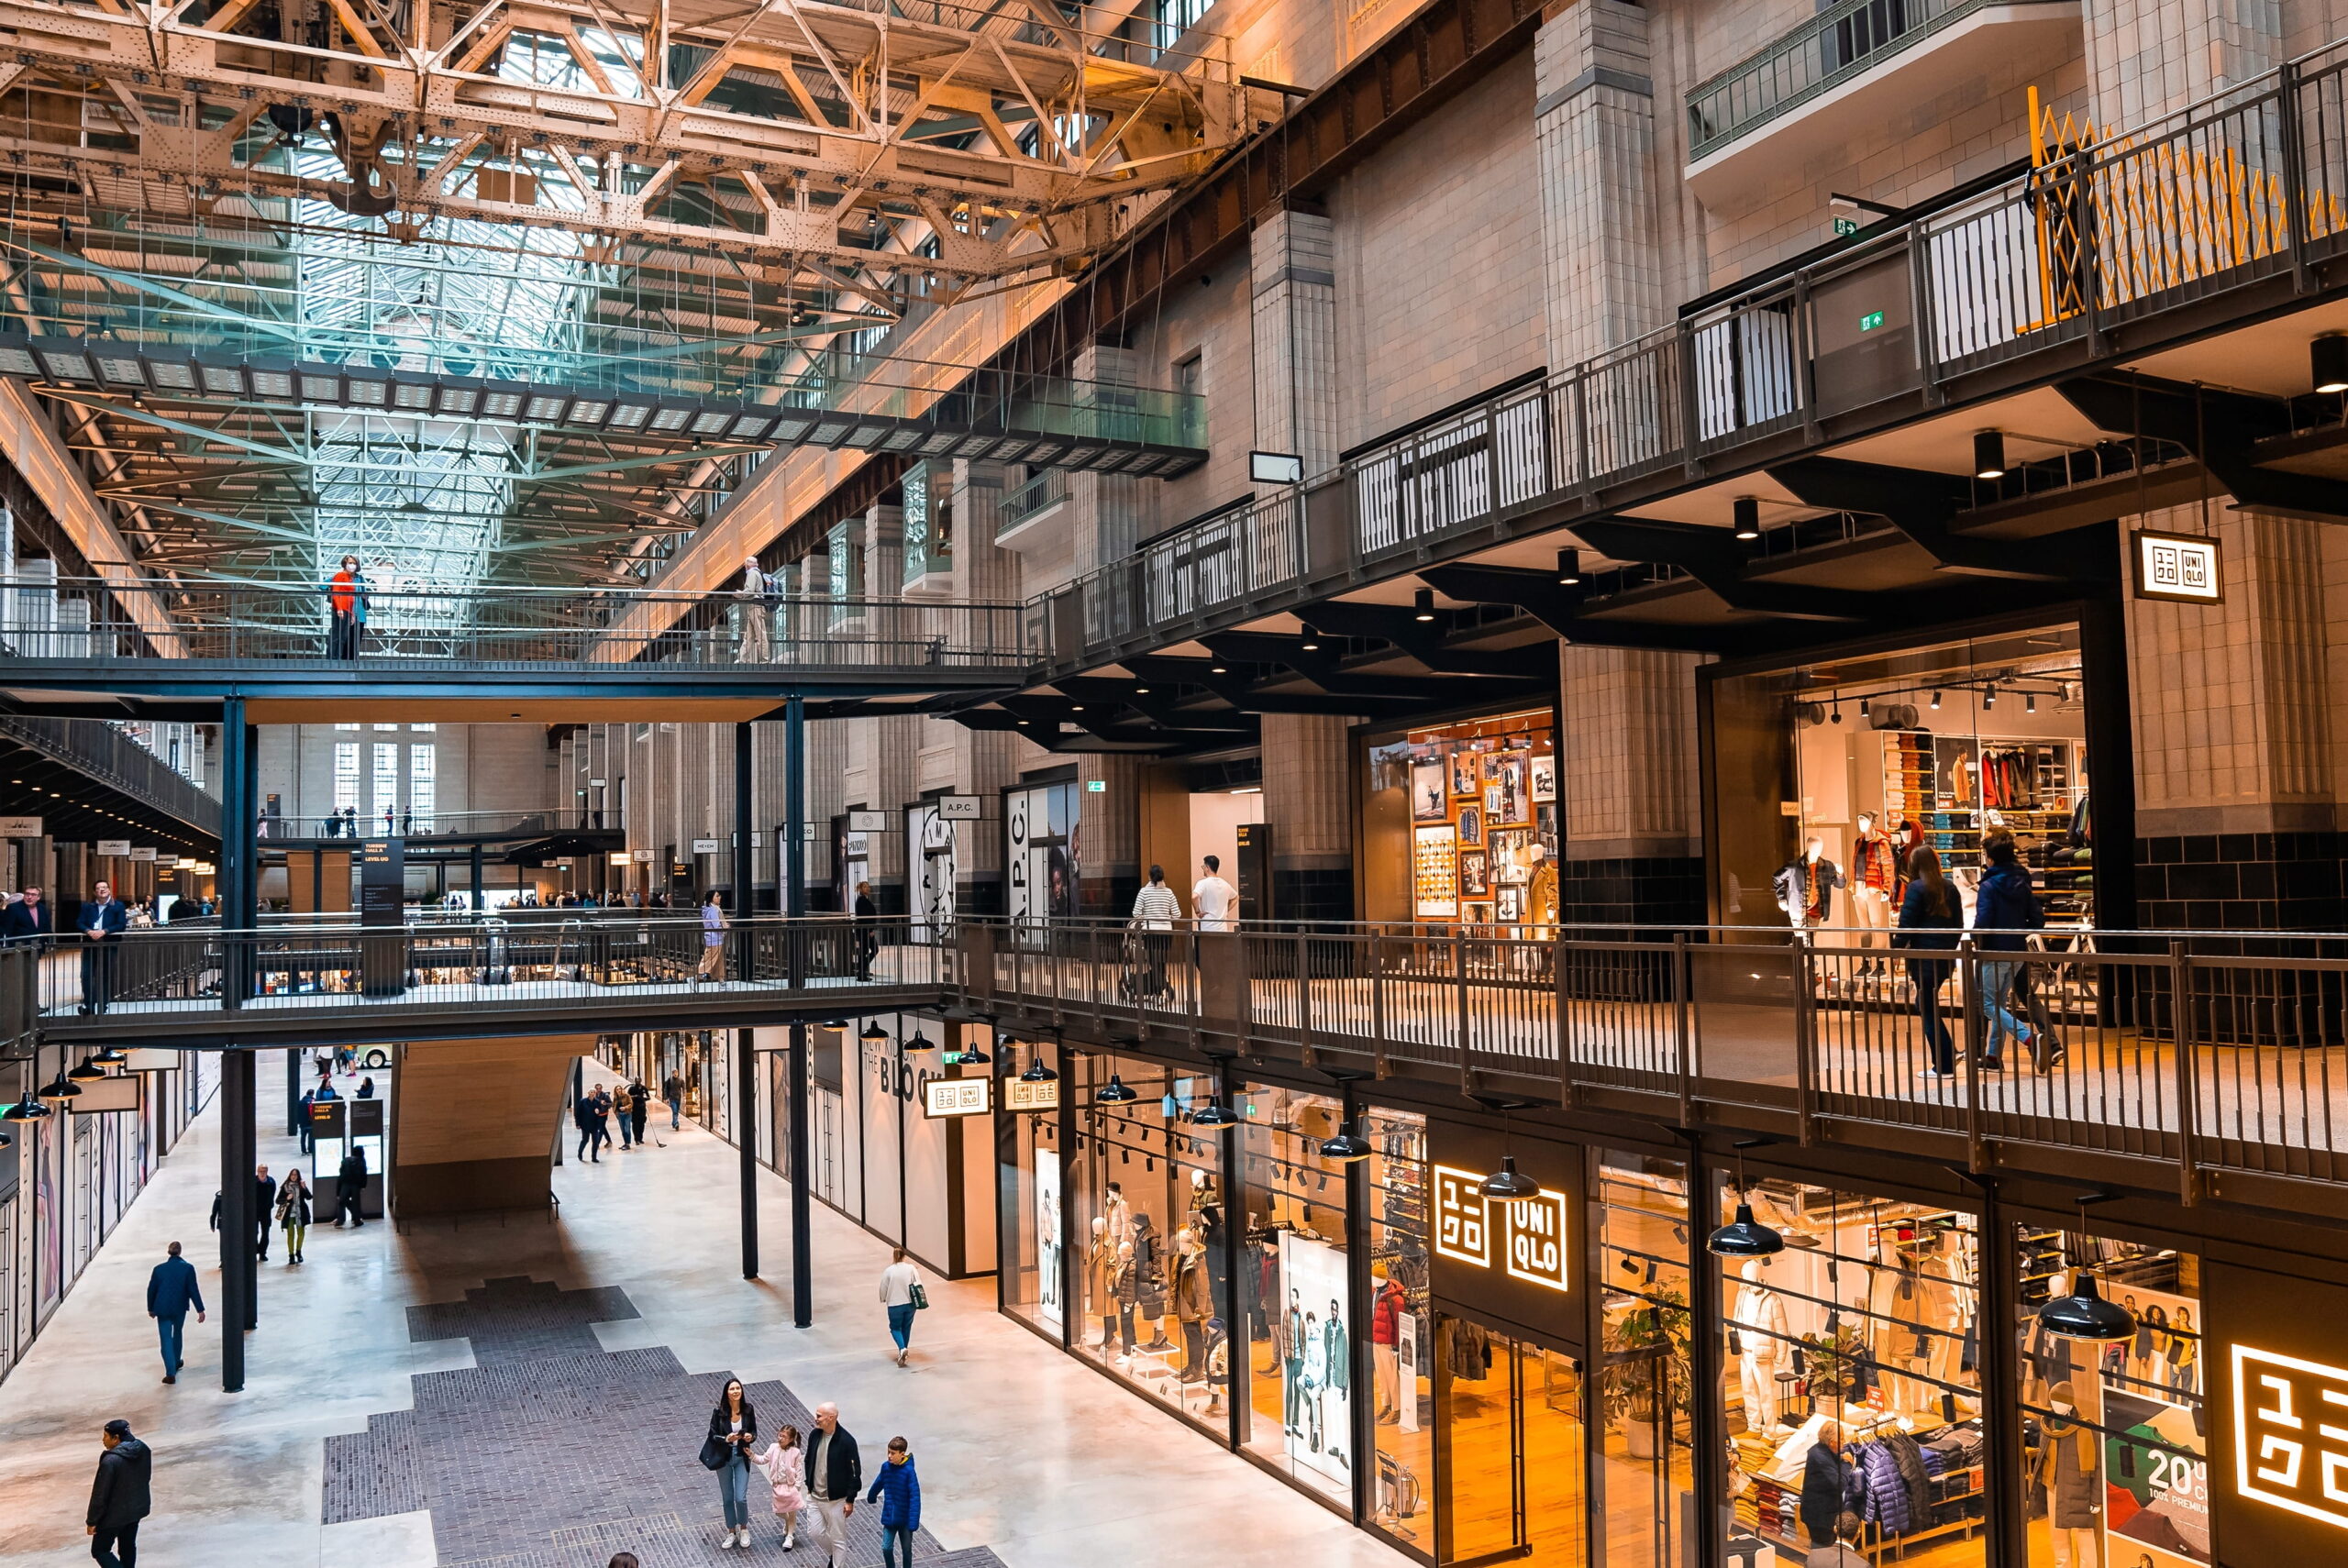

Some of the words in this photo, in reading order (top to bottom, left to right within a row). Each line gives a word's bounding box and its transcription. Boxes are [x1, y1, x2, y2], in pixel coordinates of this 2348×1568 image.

[2185, 556, 2200, 569] UNI
[2186, 569, 2203, 582] QLO
[947, 803, 973, 812] A.P.C.
[885, 1036, 898, 1058] KID
[864, 1052, 878, 1074] THE
[880, 1056, 942, 1108] BLOC
[962, 1088, 976, 1097] UNI
[962, 1096, 977, 1104] QLO
[1514, 1199, 1553, 1237] UNI
[1514, 1233, 1557, 1272] QLO
[2147, 1449, 2192, 1496] 20
[2148, 1487, 2169, 1503] 100%
